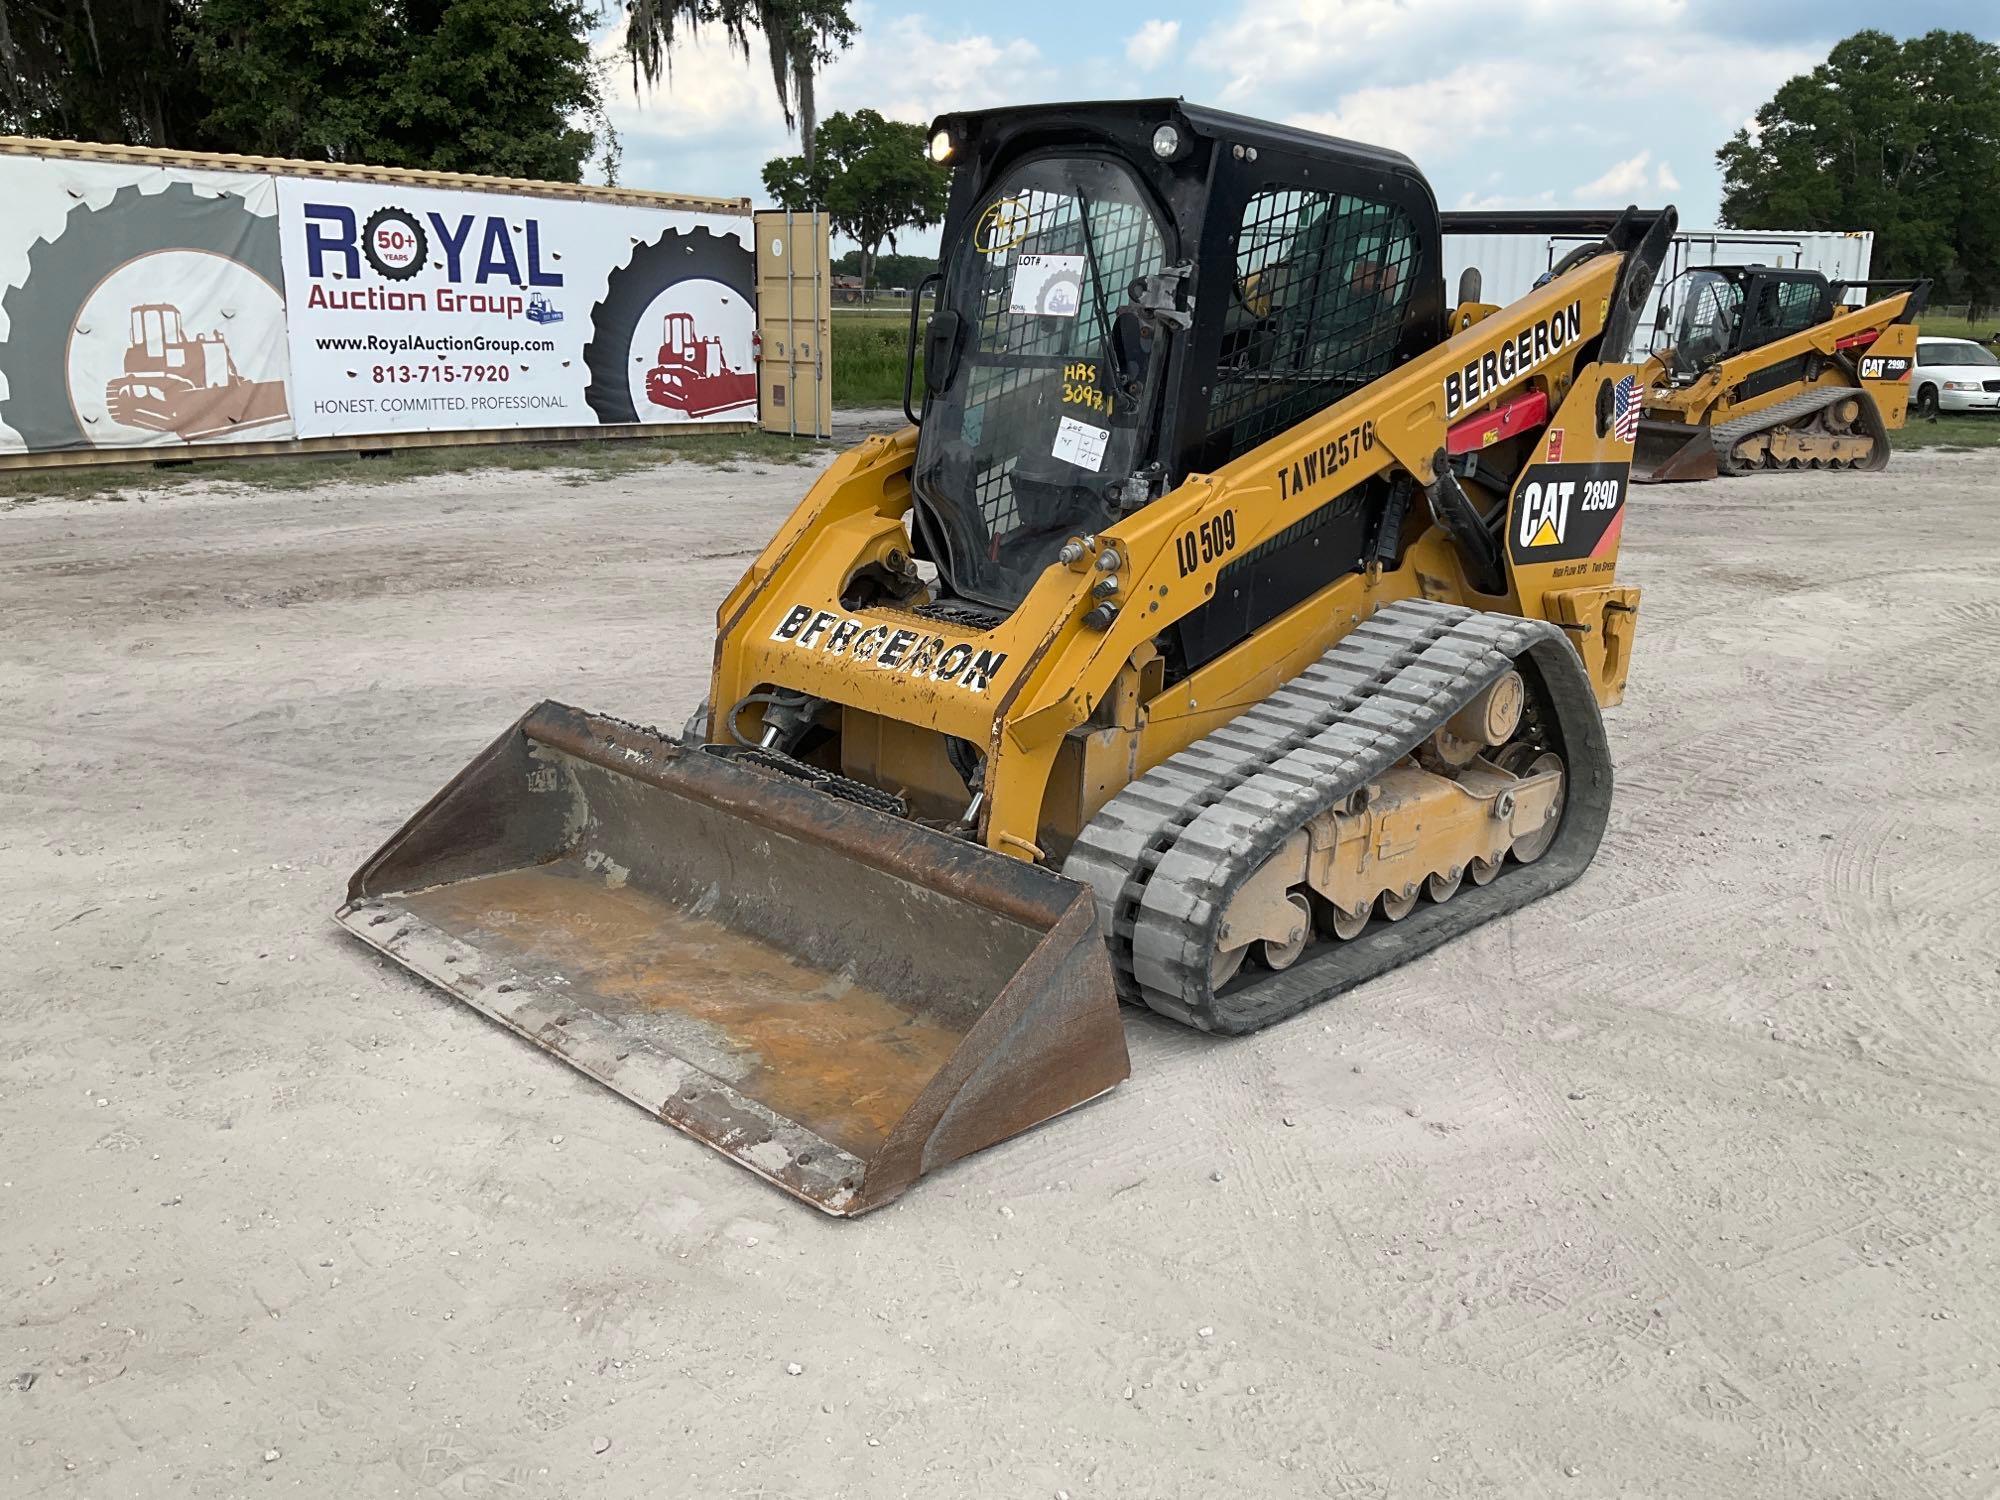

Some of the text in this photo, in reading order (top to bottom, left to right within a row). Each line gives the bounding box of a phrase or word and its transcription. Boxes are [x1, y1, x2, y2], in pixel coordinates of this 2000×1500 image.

[378, 230, 415, 250] 50+
[384, 253, 409, 262] YEARS
[1018, 256, 1041, 266] LOT#
[308, 284, 523, 320] Auction Group
[316, 334, 555, 355] www.RoyalAuctionGroup.com
[1443, 299, 1581, 420] BERGERON
[1861, 358, 1886, 378] CAT
[372, 365, 510, 383] 813-715-7920
[1063, 363, 1097, 383] HRS
[314, 395, 568, 413] HONEST. COMMITTED. PROFESSIONAL.
[1520, 480, 1619, 548] CAT 289D
[1200, 509, 1236, 564] 509
